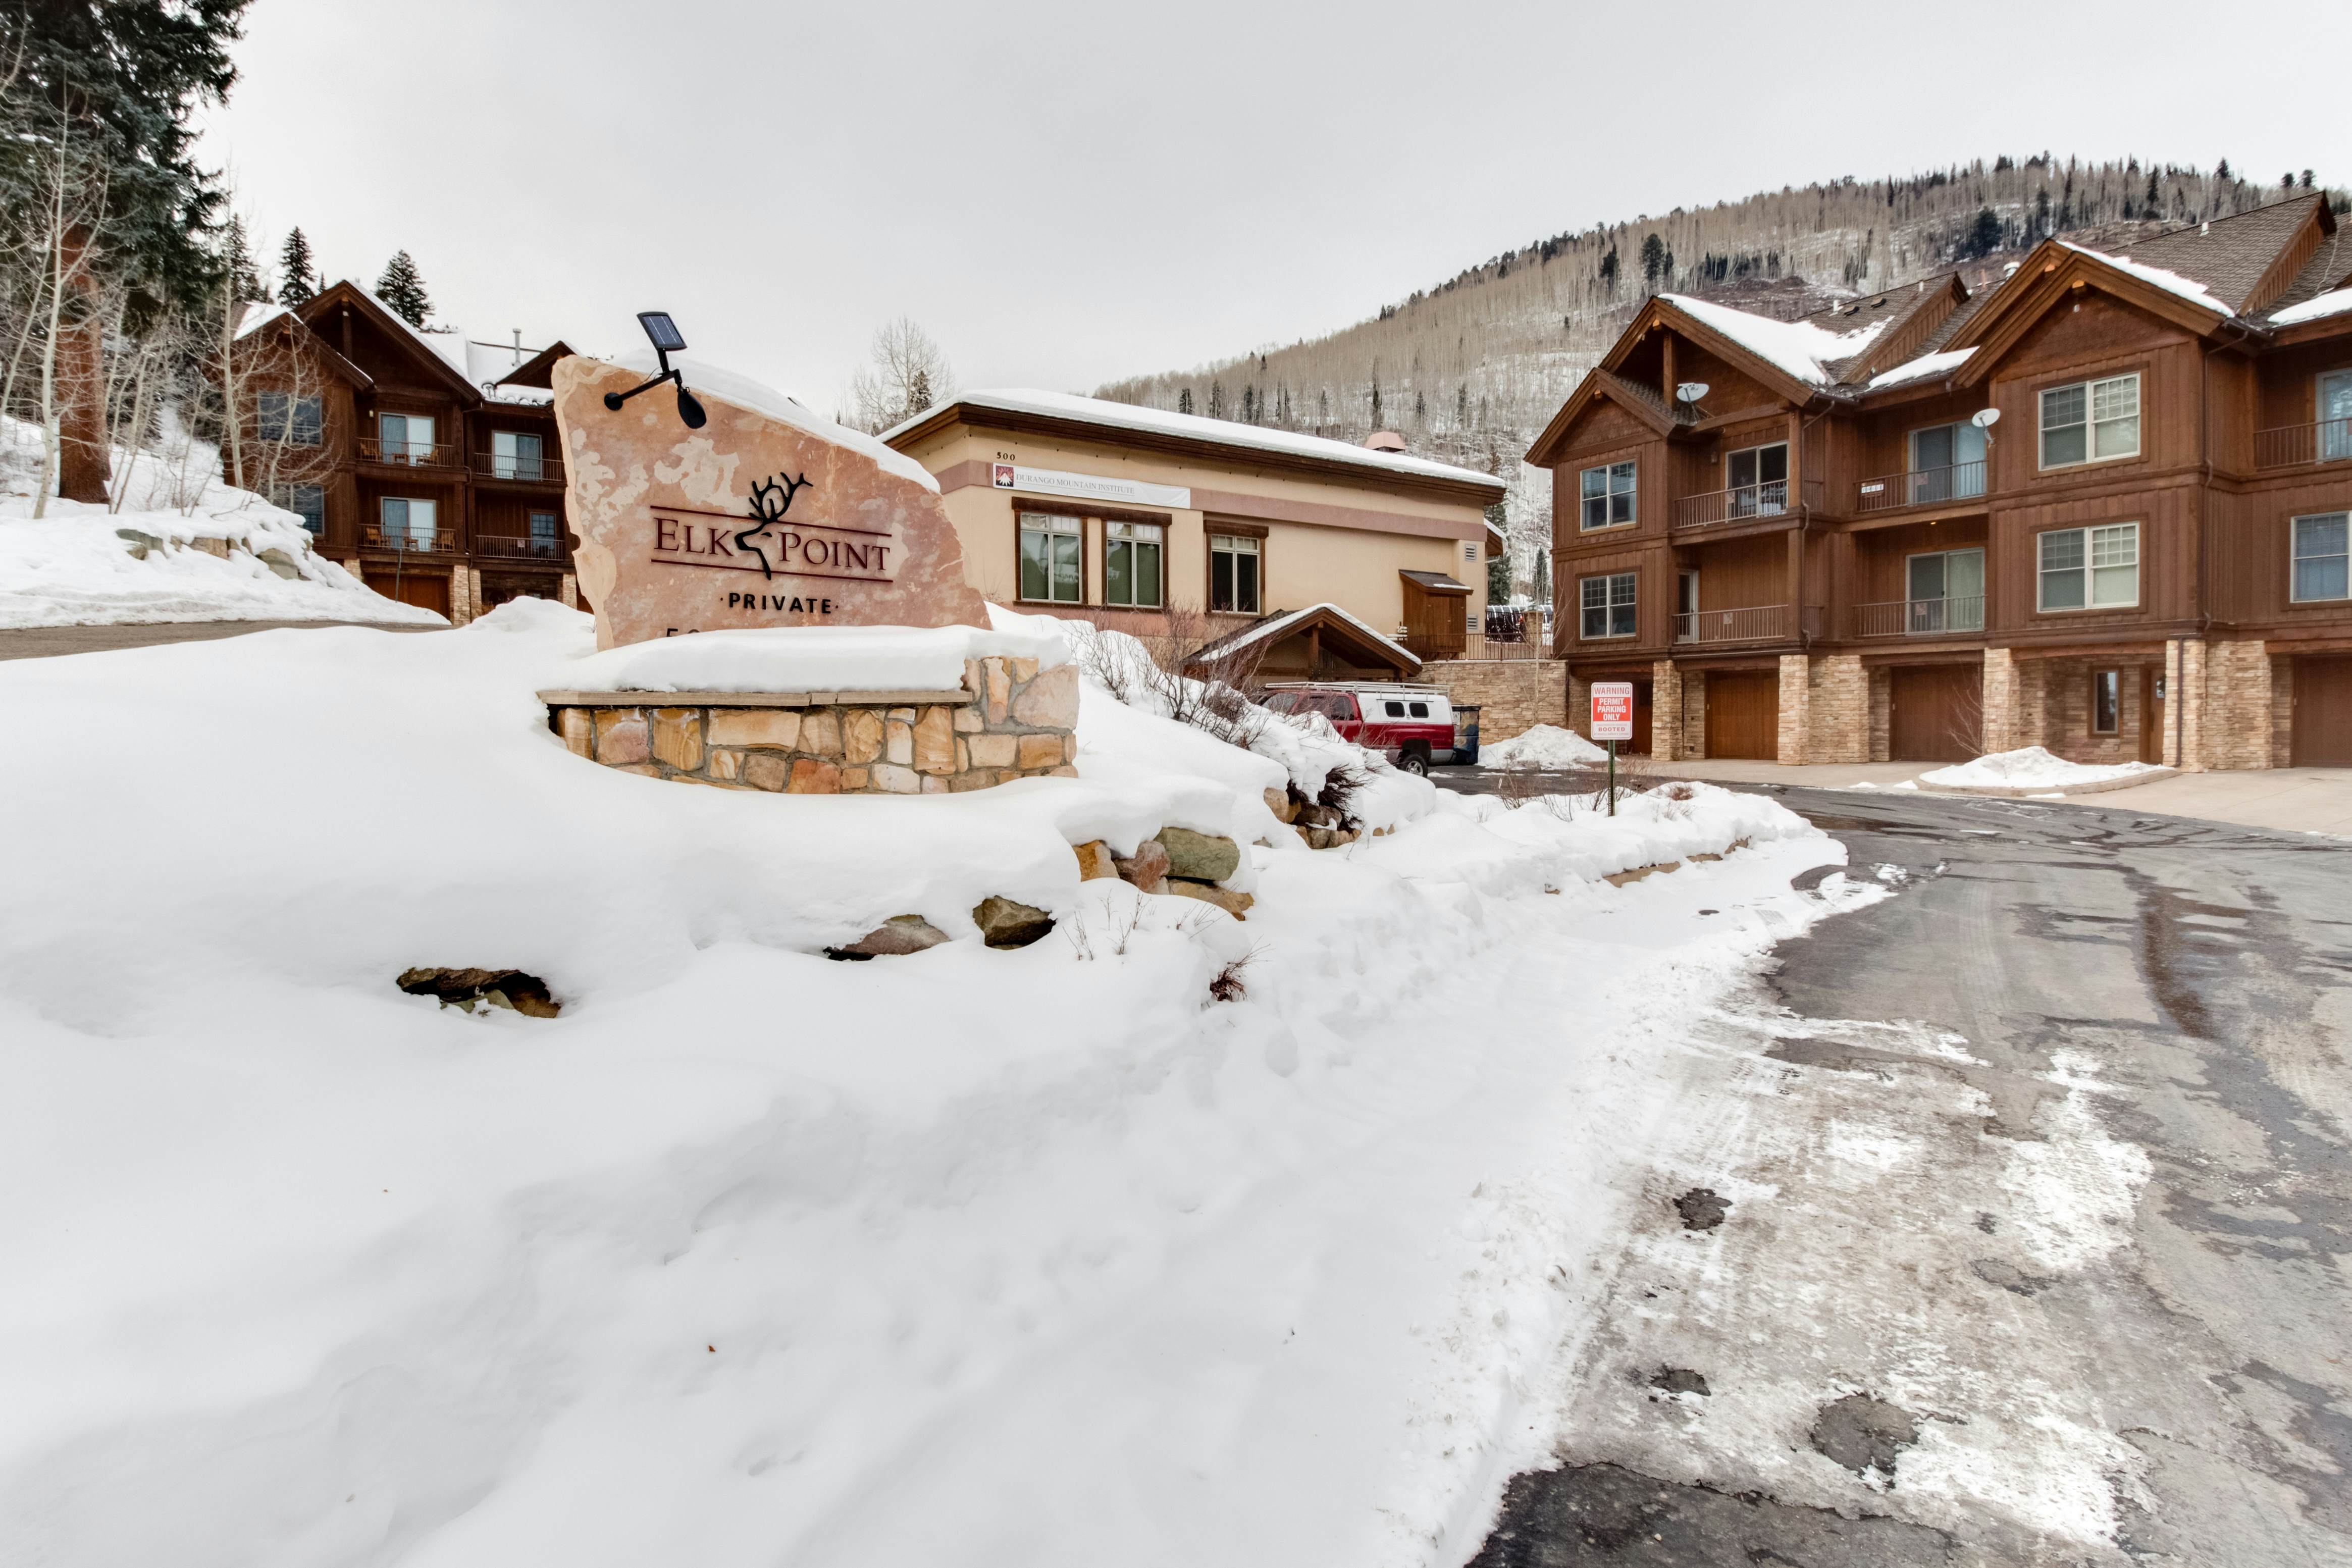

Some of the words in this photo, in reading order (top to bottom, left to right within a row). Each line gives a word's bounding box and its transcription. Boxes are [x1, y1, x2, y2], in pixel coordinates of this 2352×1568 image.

[997, 452, 1015, 461] 500
[1016, 474, 1055, 485] DURANGO
[1057, 479, 1096, 489] MOUNTAIN
[1099, 484, 1134, 494] INSTITUTE
[654, 517, 734, 557] ELK
[778, 532, 890, 571] POINT
[728, 592, 831, 614] PRIVATE
